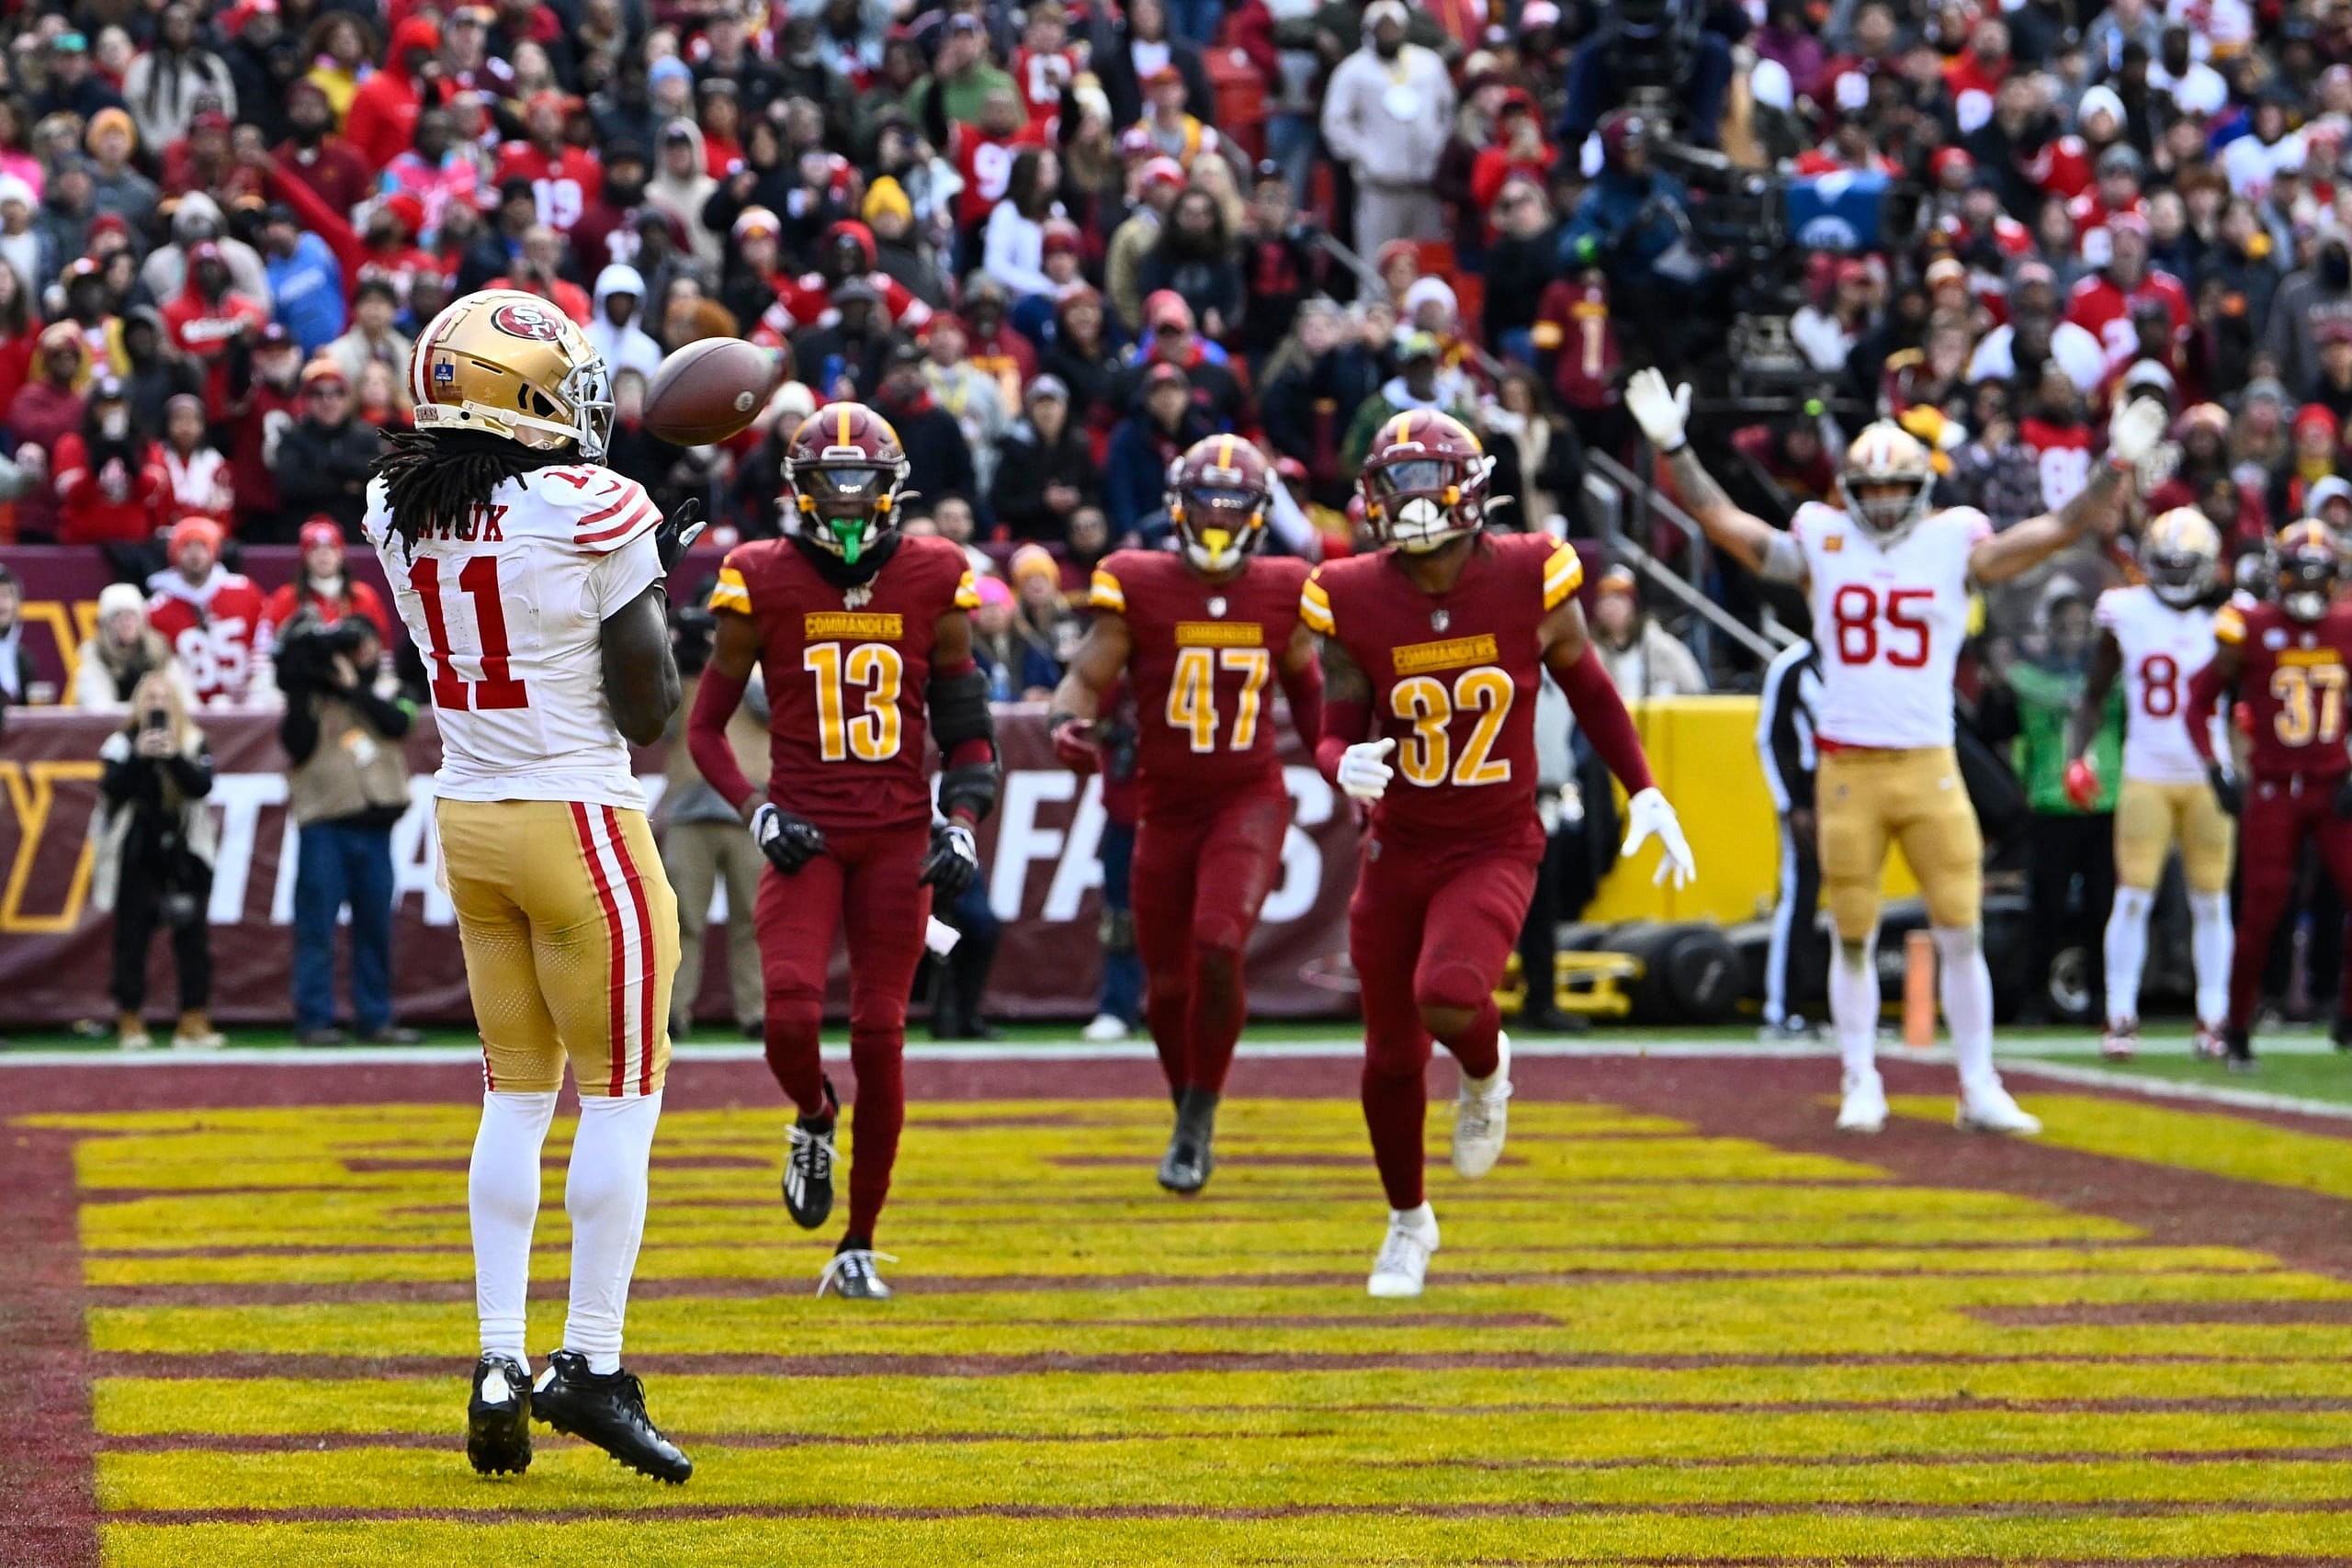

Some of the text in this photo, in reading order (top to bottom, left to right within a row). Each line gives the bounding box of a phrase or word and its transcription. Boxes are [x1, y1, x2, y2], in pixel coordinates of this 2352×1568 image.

[531, 177, 583, 228] 19
[175, 616, 247, 689] 85
[408, 555, 529, 712] 11
[804, 615, 903, 635] COMMANDERS
[1833, 584, 1936, 668] 85
[803, 641, 904, 761] 13
[1165, 647, 1271, 753] 47
[1390, 666, 1515, 787] 32
[2142, 654, 2178, 718] 8
[2269, 662, 2350, 748] 37
[988, 765, 1334, 922] FAS
